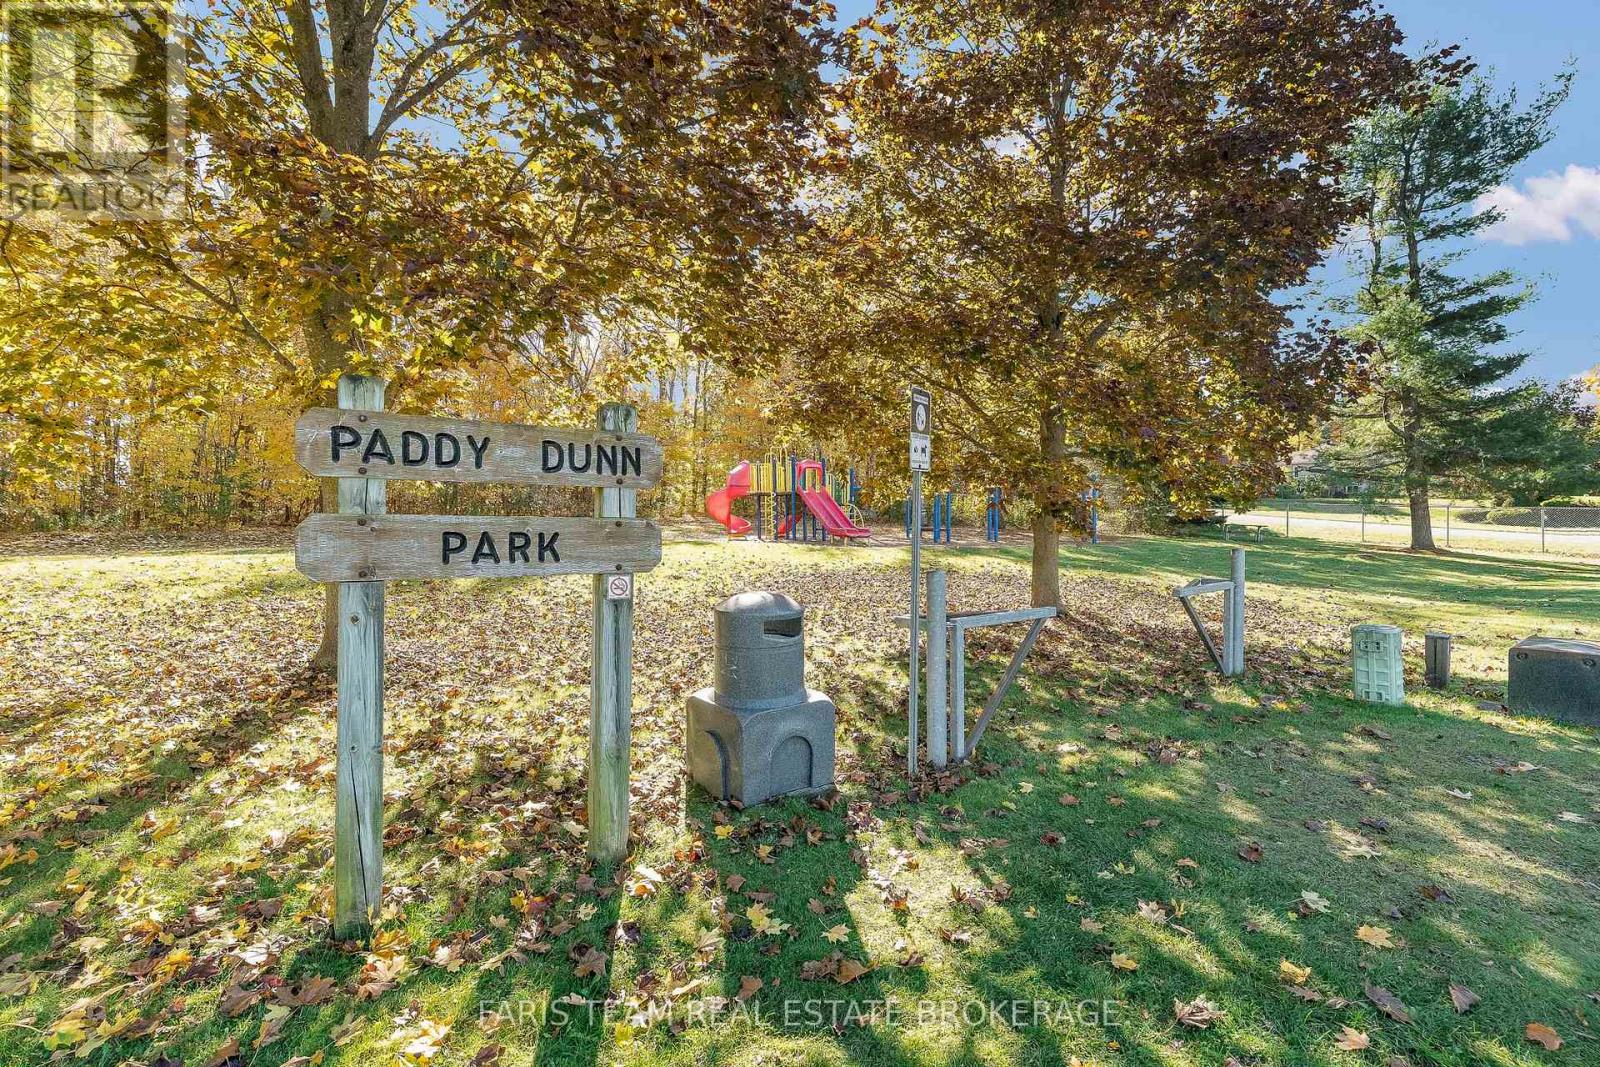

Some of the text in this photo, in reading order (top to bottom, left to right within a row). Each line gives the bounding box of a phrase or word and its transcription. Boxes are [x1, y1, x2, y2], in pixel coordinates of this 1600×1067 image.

[331, 425, 641, 476] PADDY DUNN
[442, 531, 561, 564] PARK
